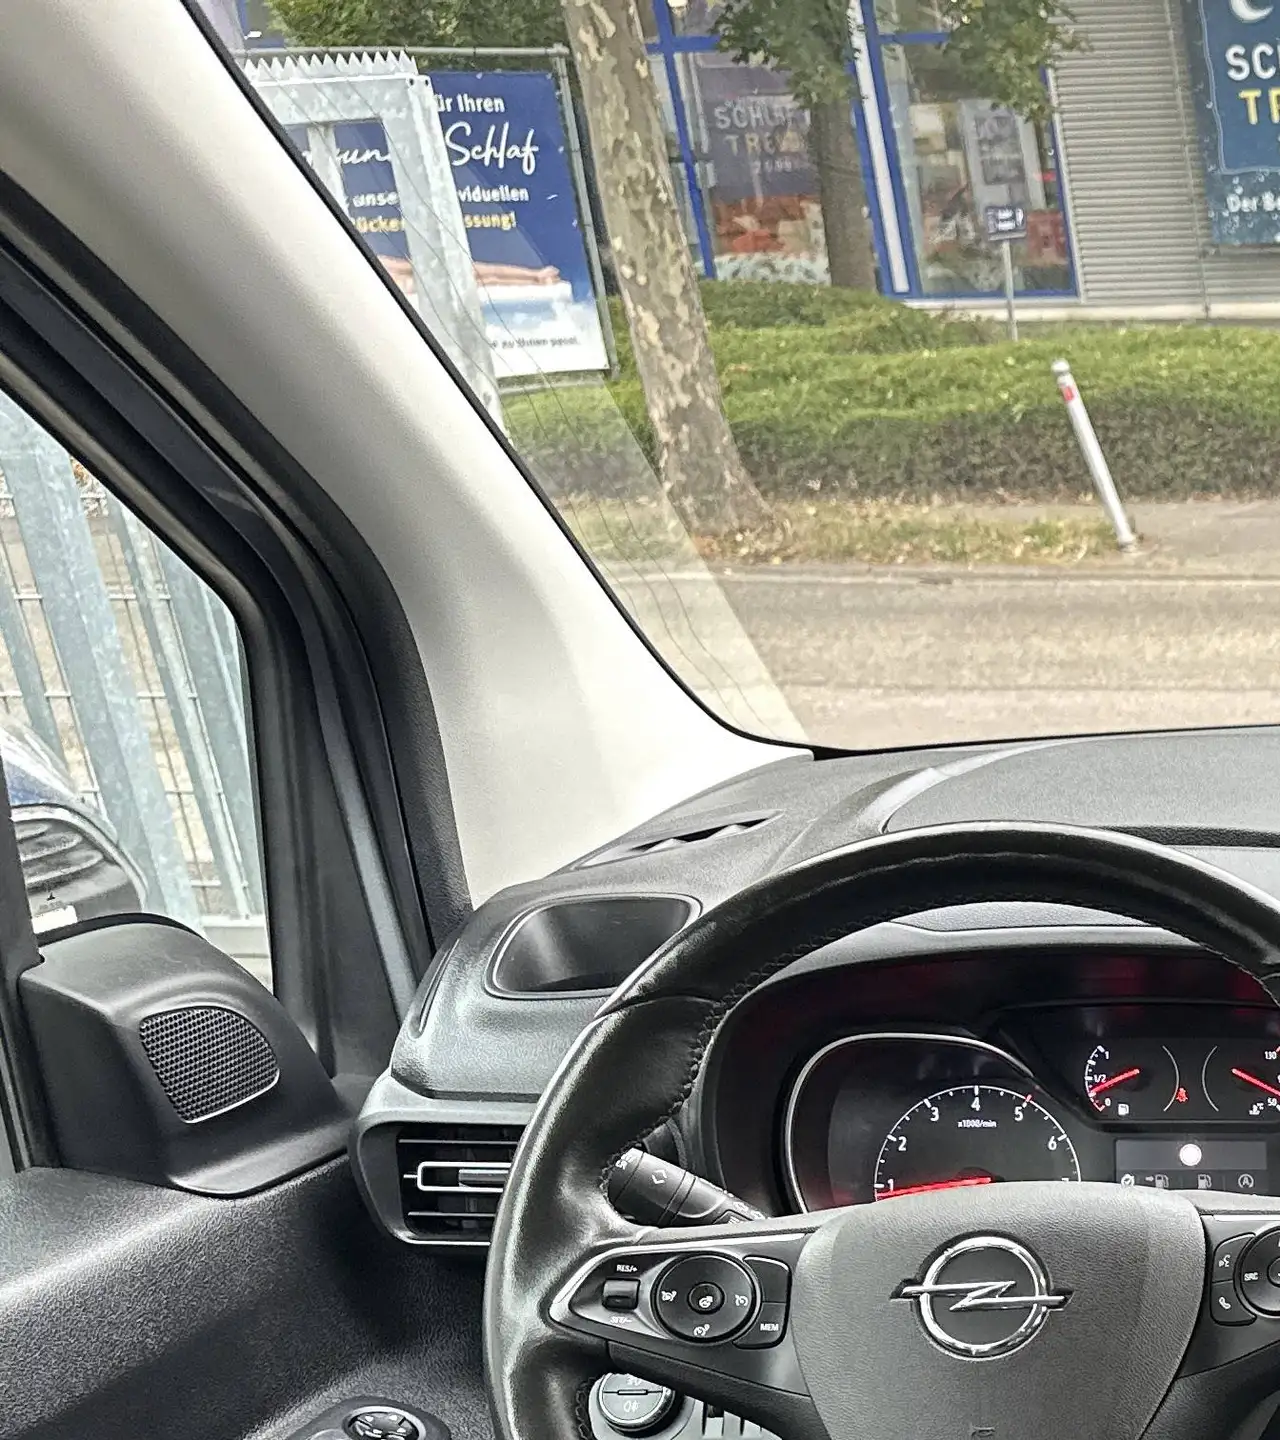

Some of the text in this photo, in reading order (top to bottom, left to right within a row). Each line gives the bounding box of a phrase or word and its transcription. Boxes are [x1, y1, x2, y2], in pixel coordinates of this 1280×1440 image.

[457, 92, 505, 113] Ihren
[445, 121, 539, 175] Schlaf
[1226, 192, 1258, 212] Der
[970, 1097, 981, 1112] 4
[1267, 1098, 1278, 1107] 50
[930, 1107, 940, 1122] 3
[1014, 1107, 1024, 1122] 5
[897, 1136, 907, 1151] 2
[1048, 1136, 1058, 1151] 6
[887, 1178, 894, 1192] 1
[760, 1323, 779, 1332] MEM
